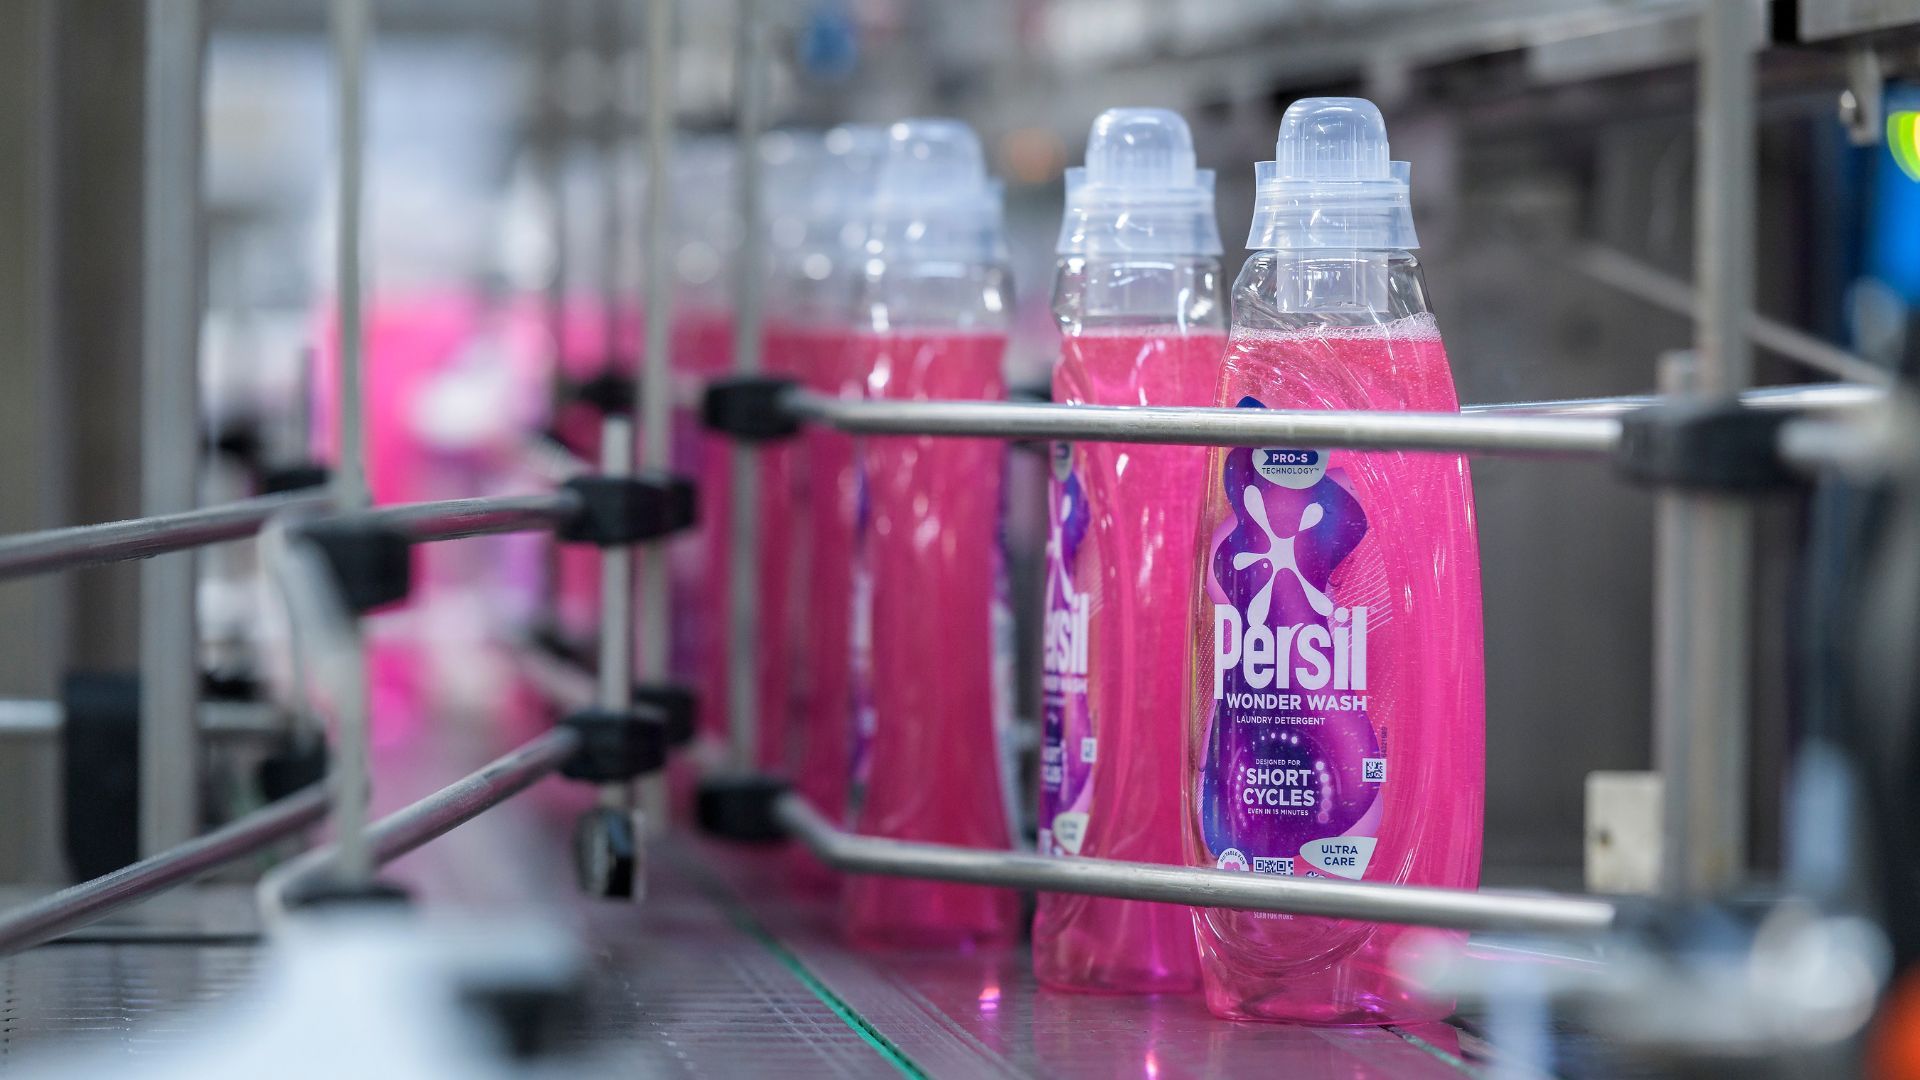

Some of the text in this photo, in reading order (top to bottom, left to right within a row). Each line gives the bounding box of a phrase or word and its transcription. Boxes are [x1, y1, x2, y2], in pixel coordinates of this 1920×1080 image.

[1272, 453, 1308, 463] PRO-S
[1213, 603, 1367, 699] Persil
[1226, 693, 1367, 711] WONDER WASH
[1236, 715, 1326, 725] LAUNDRY DETERGENT
[1246, 767, 1312, 786] SHORT
[1242, 787, 1316, 807] CYCLES
[1321, 844, 1359, 855] ULTRA
[1323, 856, 1356, 866] CARE
